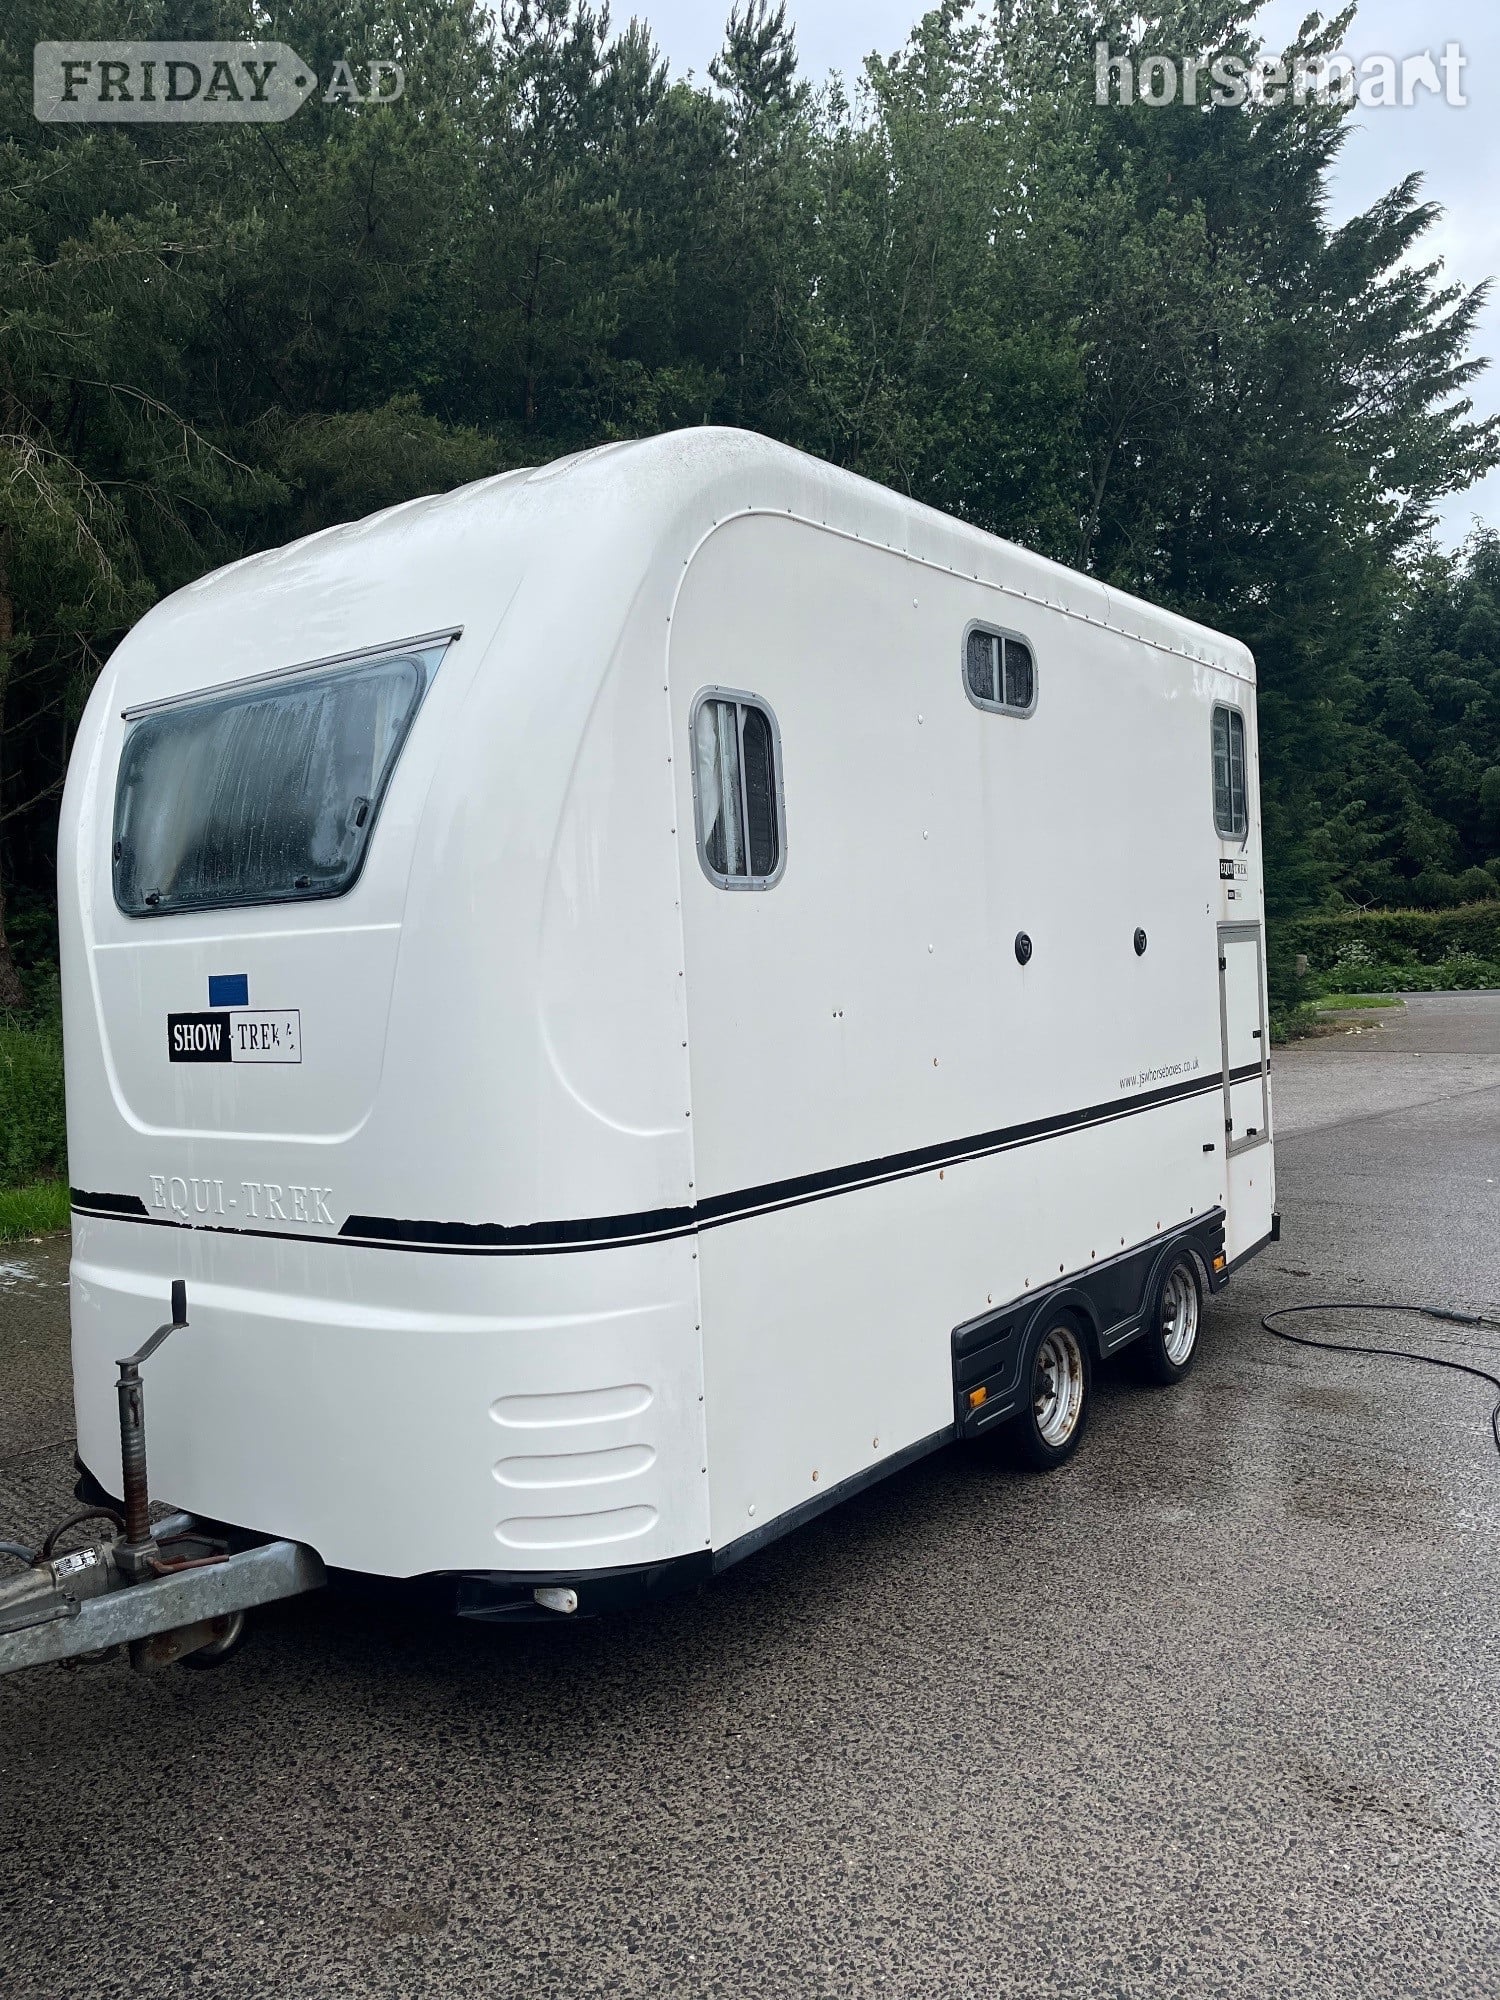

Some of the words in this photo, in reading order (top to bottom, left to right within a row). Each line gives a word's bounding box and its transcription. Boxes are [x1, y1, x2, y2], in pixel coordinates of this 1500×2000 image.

[173, 1023, 222, 1052] SHOW
[1119, 1056, 1200, 1089] www.jswhorseboxes.co.uk
[149, 1174, 335, 1224] EQUI-TREK
